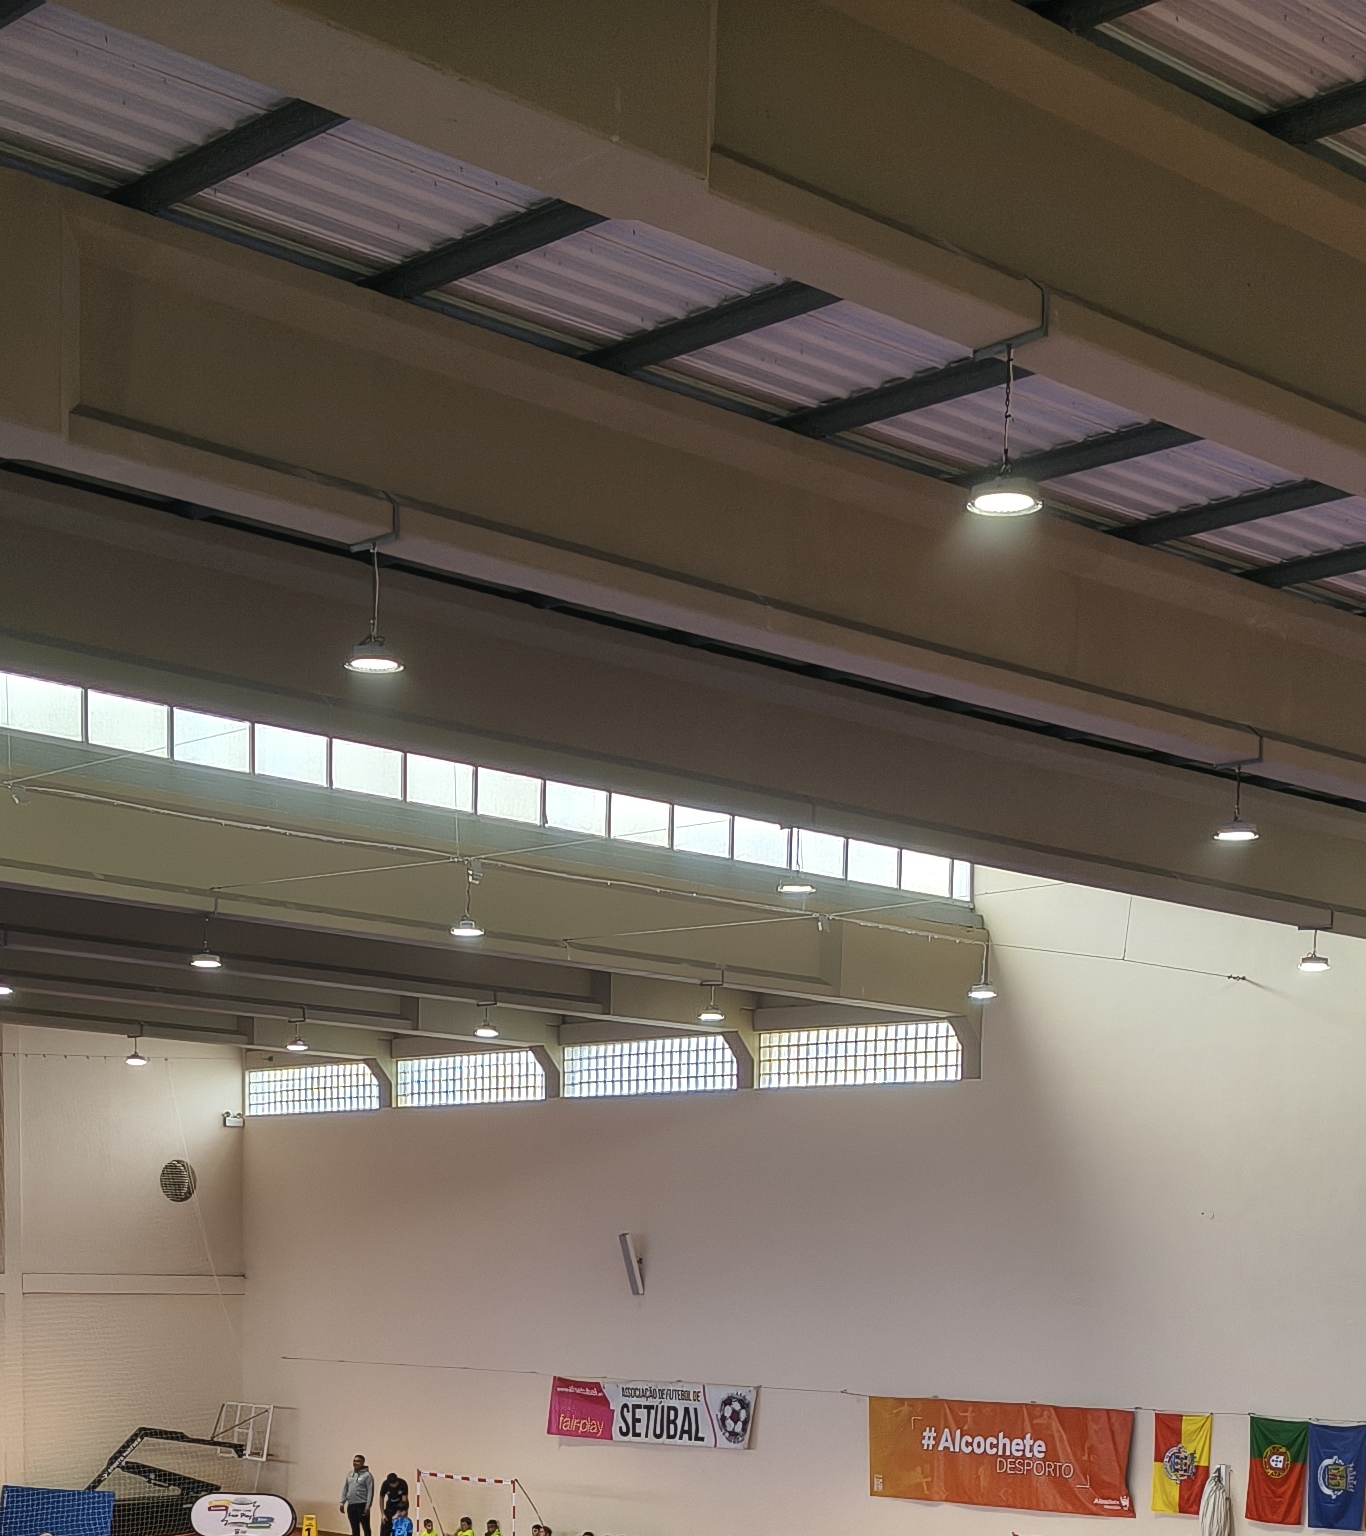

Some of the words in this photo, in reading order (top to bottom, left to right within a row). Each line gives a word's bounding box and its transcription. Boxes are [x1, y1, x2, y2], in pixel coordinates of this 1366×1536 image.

[621, 1386, 657, 1402] ASSOCIAÇÃO
[666, 1388, 692, 1402] FUTEBOL
[692, 1390, 701, 1402] DE
[619, 1400, 705, 1442] SETÚBAL
[921, 1426, 1047, 1459] #Alcochete
[996, 1457, 1074, 1479] DESPORTO
